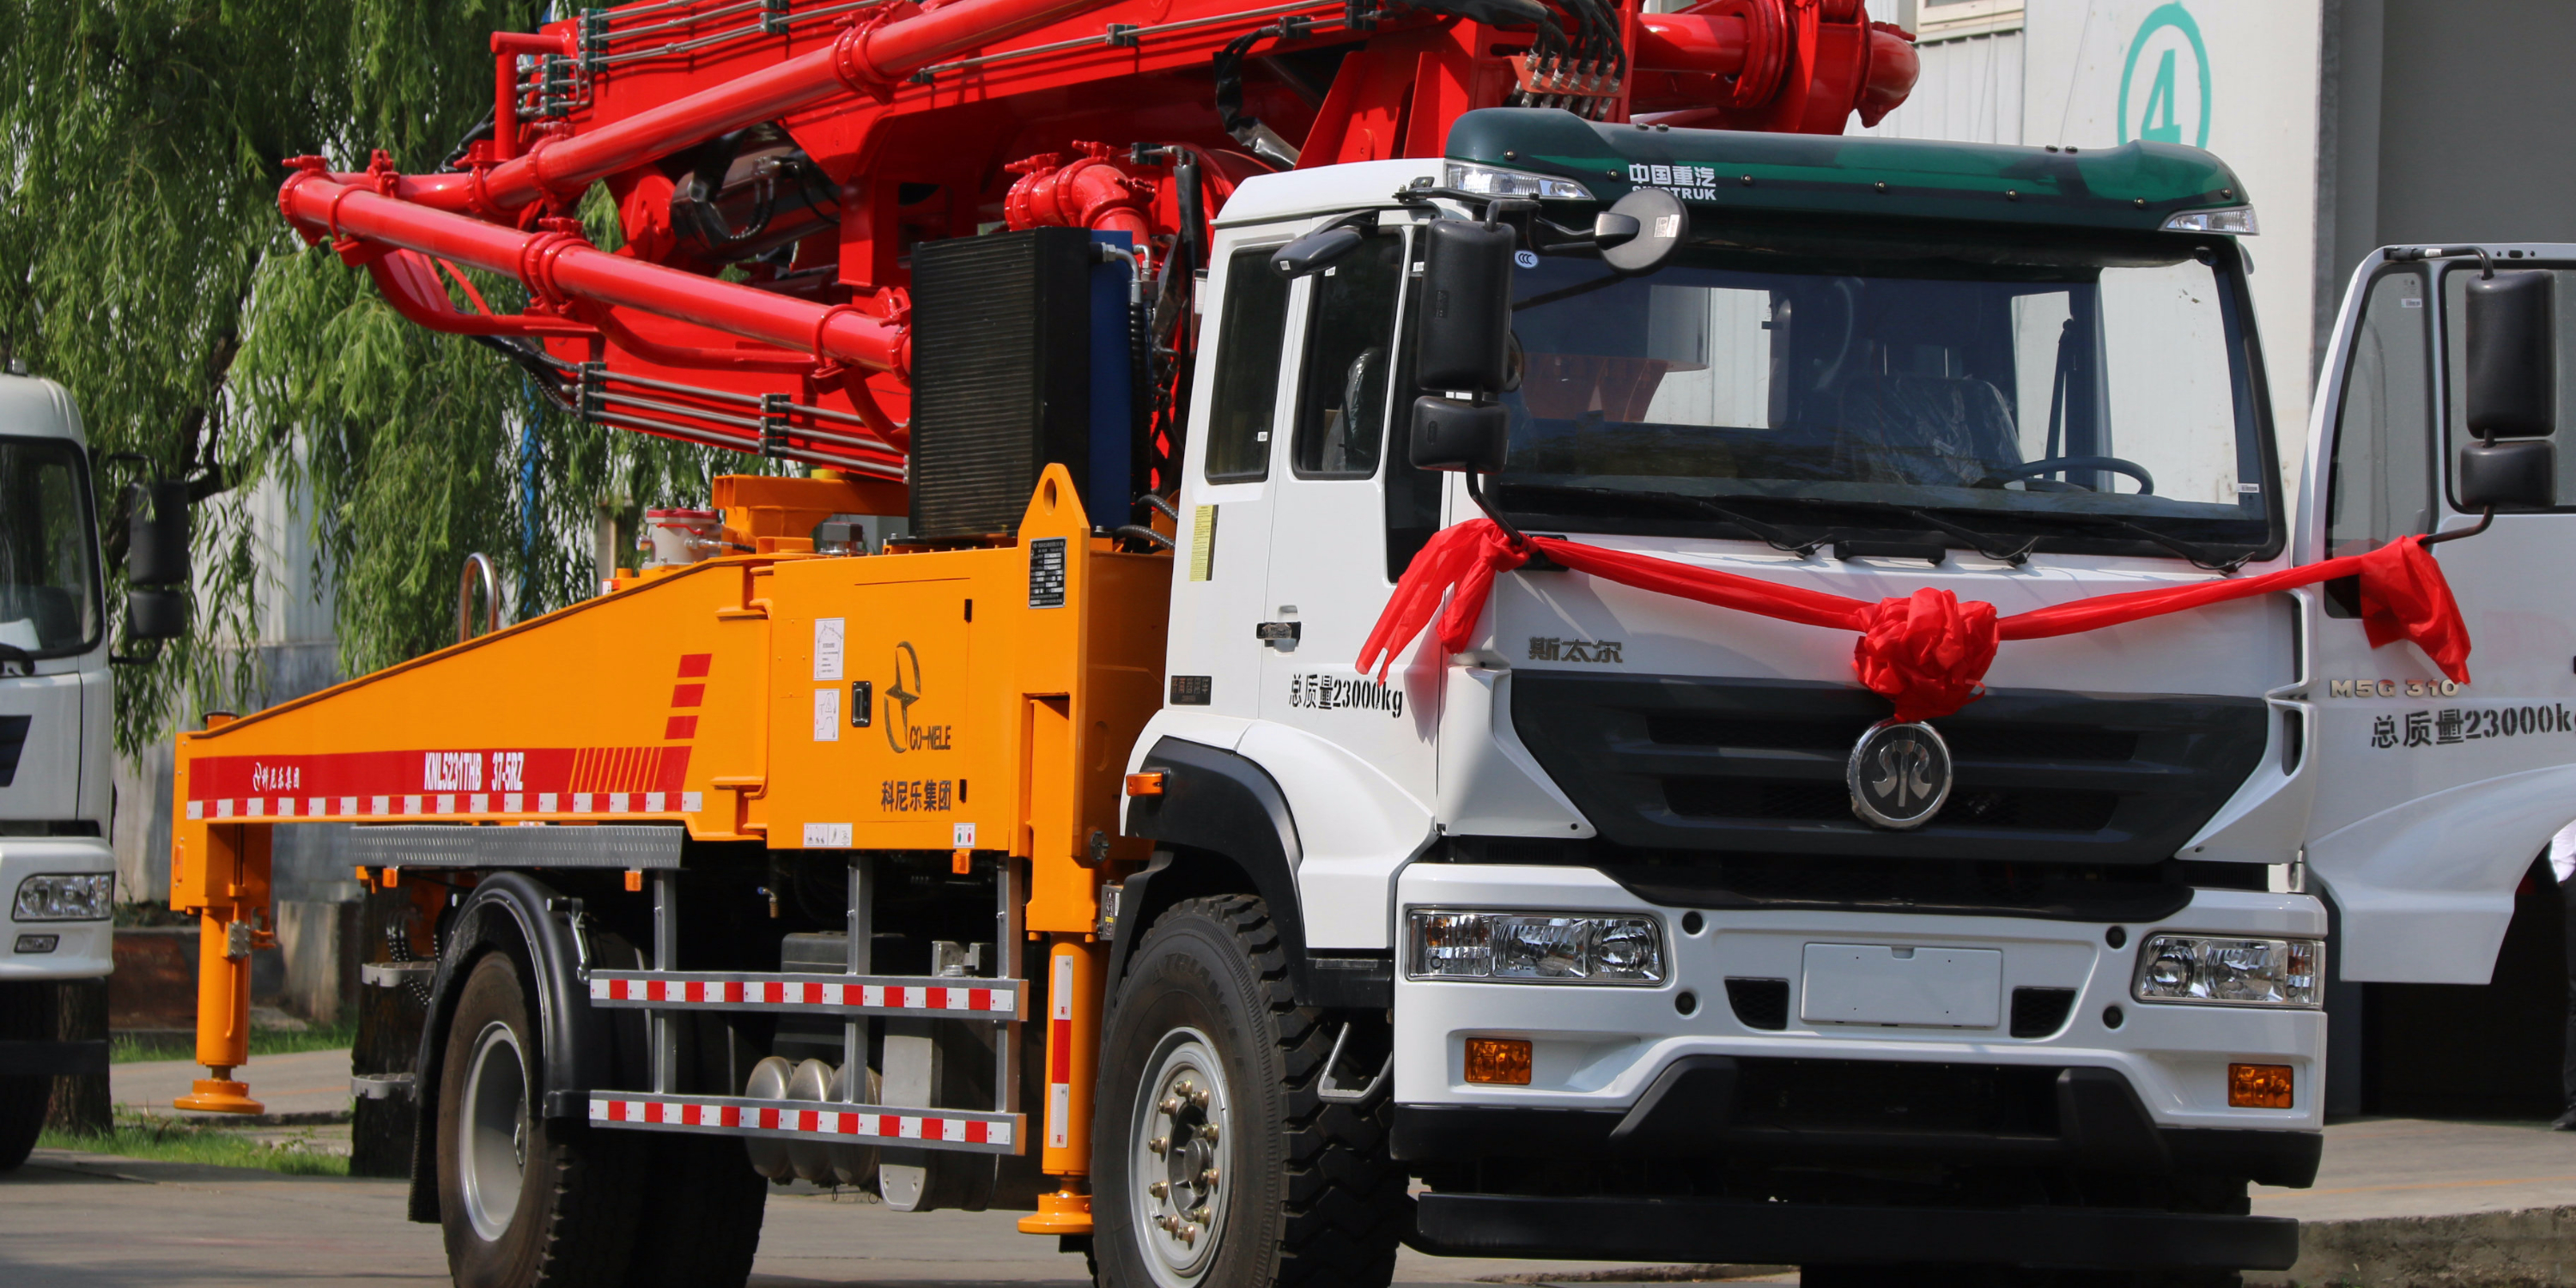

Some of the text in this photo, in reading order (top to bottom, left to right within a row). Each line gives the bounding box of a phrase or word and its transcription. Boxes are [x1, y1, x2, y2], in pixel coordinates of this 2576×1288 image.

[2141, 48, 2182, 144] 4
[1628, 163, 1716, 187] 中国重汽
[1528, 636, 1623, 663] 斯太尔
[1289, 673, 1403, 719] 总质量23000kg
[2330, 678, 2460, 698] M5G 310
[908, 725, 951, 750] CO-NELE
[2371, 702, 2576, 749] 总质量23000k
[423, 751, 525, 792] KNL5231THB 37-5RZ
[881, 779, 951, 812] 科尼乐集团
